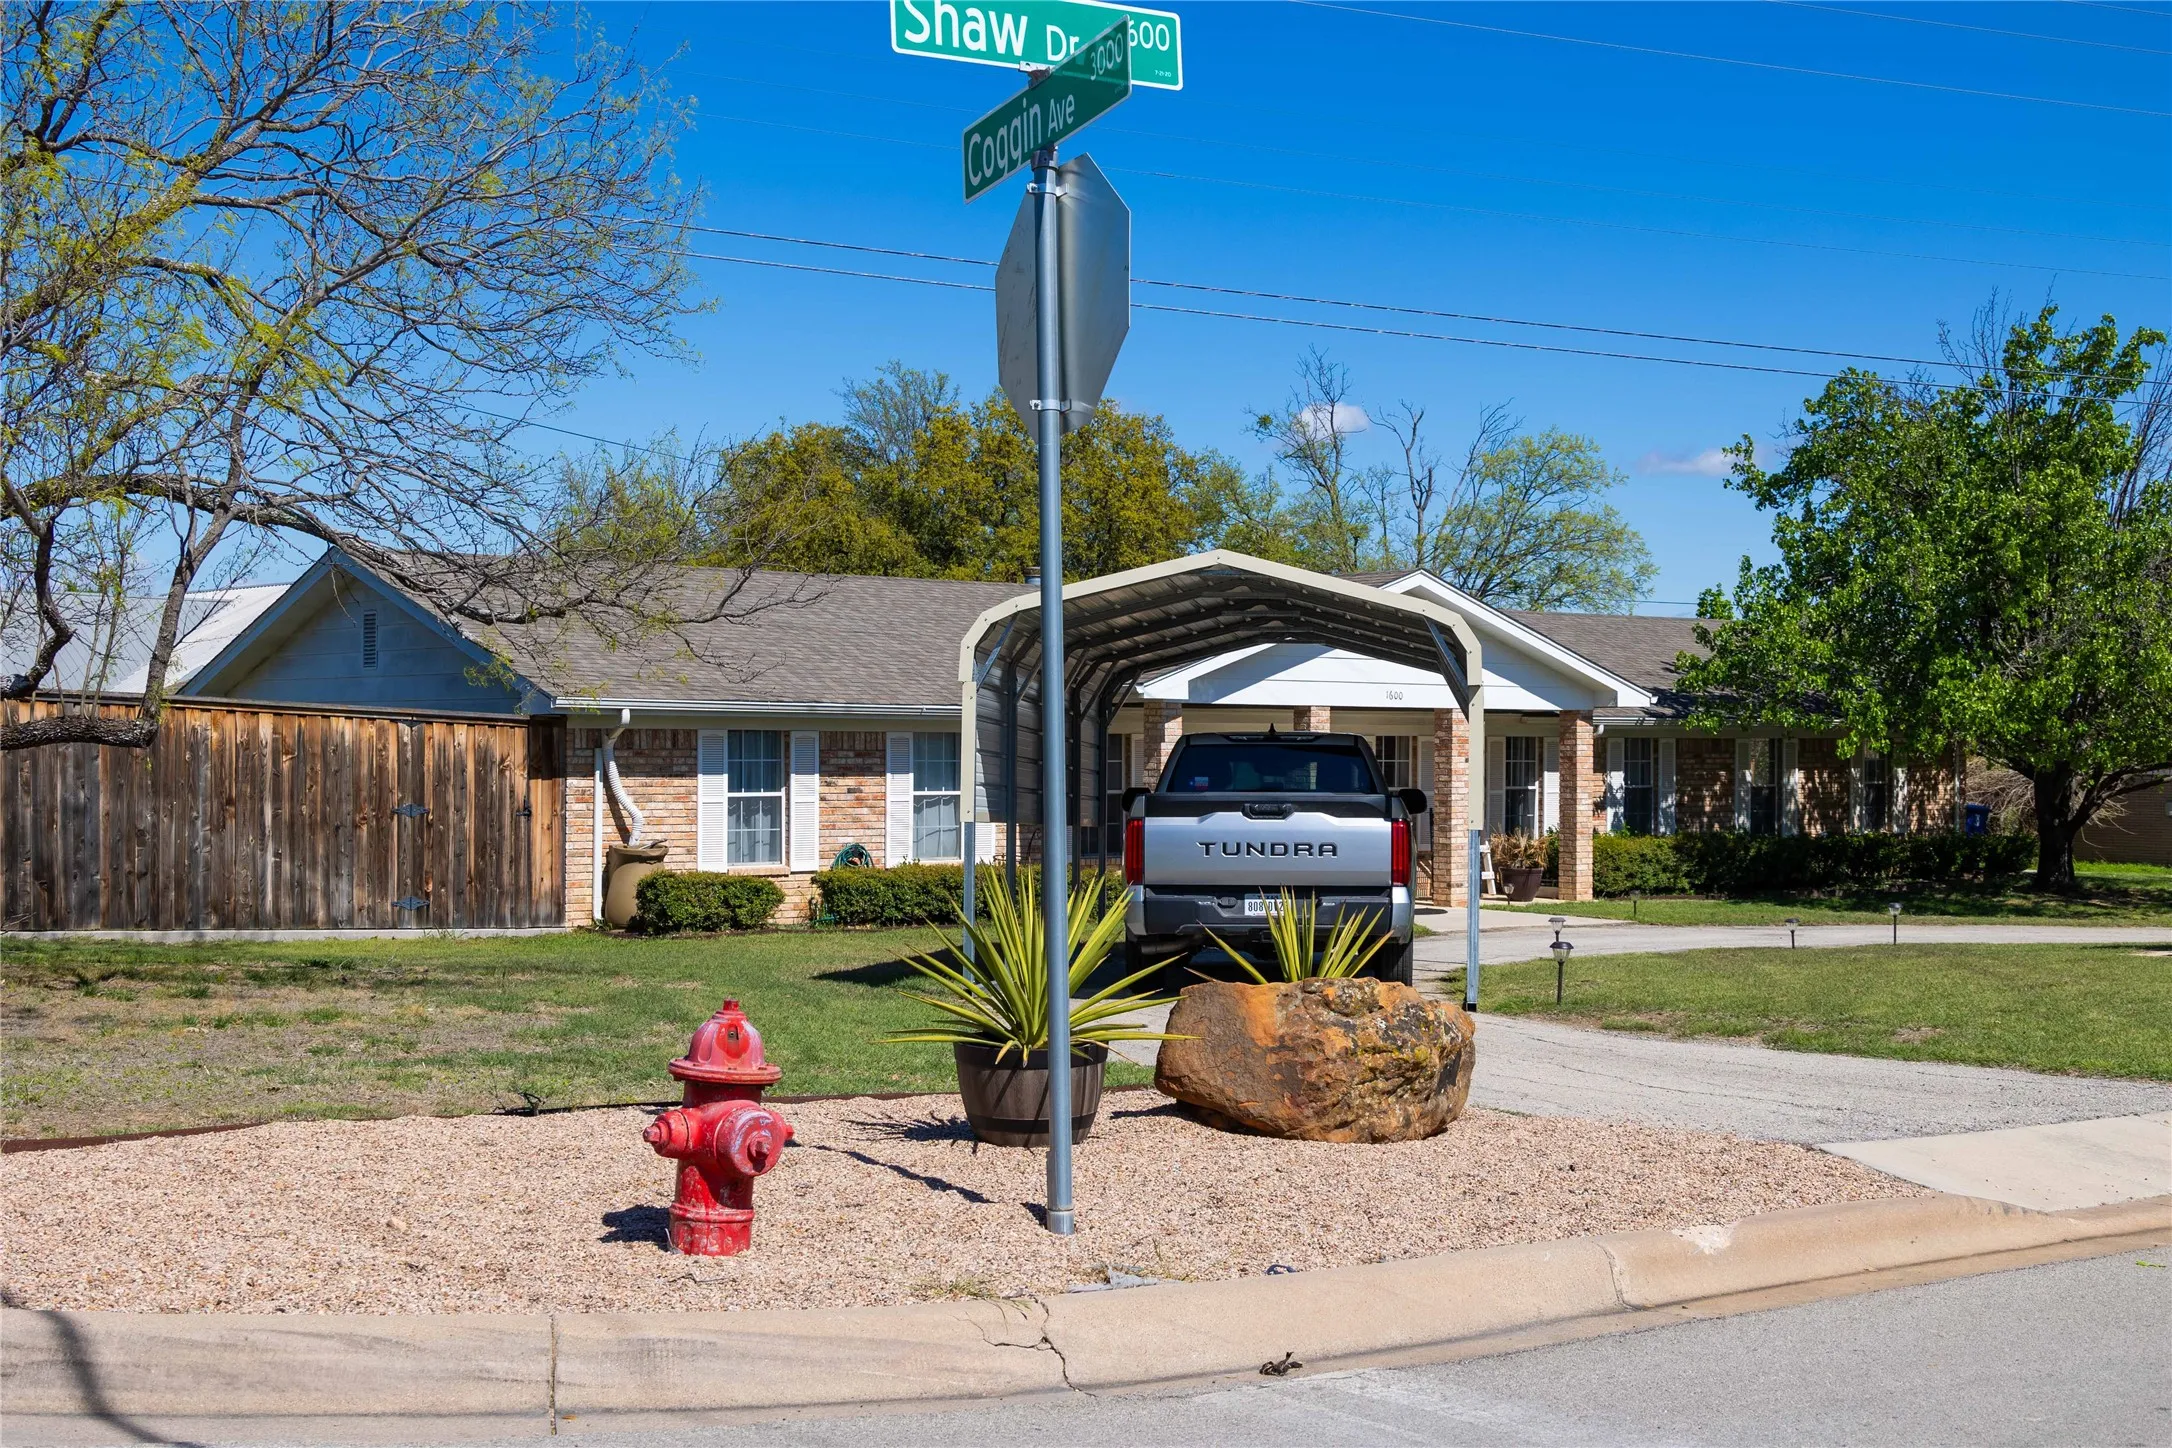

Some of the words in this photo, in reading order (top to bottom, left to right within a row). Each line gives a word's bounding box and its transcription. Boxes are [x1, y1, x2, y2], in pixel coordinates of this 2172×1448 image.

[904, 0, 1028, 56] Shaw
[1046, 25, 1079, 62] Dr
[1090, 33, 1123, 80] 3000
[968, 97, 1042, 186] Coggin
[1048, 94, 1075, 138] Ave
[1385, 690, 1403, 700] 1600
[1196, 842, 1337, 858] TUNDRA
